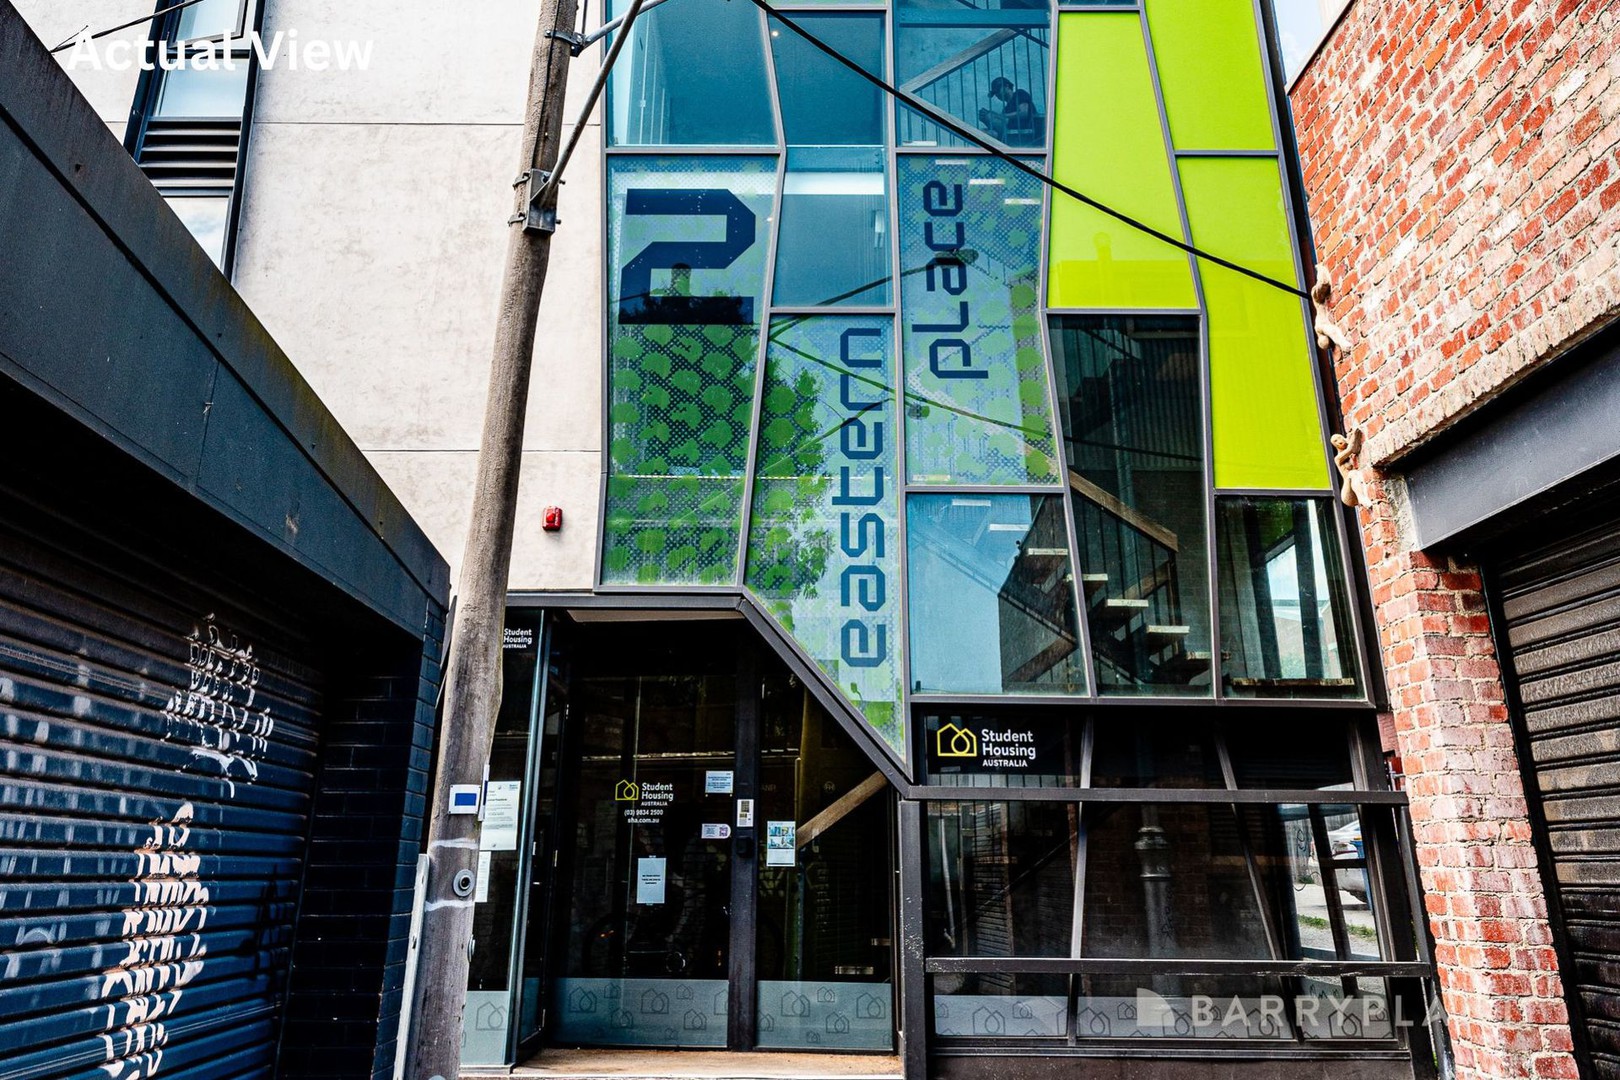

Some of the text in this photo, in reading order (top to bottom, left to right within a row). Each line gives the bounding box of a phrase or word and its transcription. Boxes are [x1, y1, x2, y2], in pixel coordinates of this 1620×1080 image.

[618, 188, 756, 325] 2
[911, 179, 989, 380] place
[832, 327, 886, 668] eastern
[503, 628, 532, 636] Student
[503, 636, 532, 645] Housing
[981, 728, 1034, 742] Student
[982, 742, 1036, 760] Housing
[982, 759, 1028, 767] AUSTRALIA
[641, 782, 673, 791] Student
[641, 791, 674, 801] Housing
[624, 809, 635, 817] (03)
